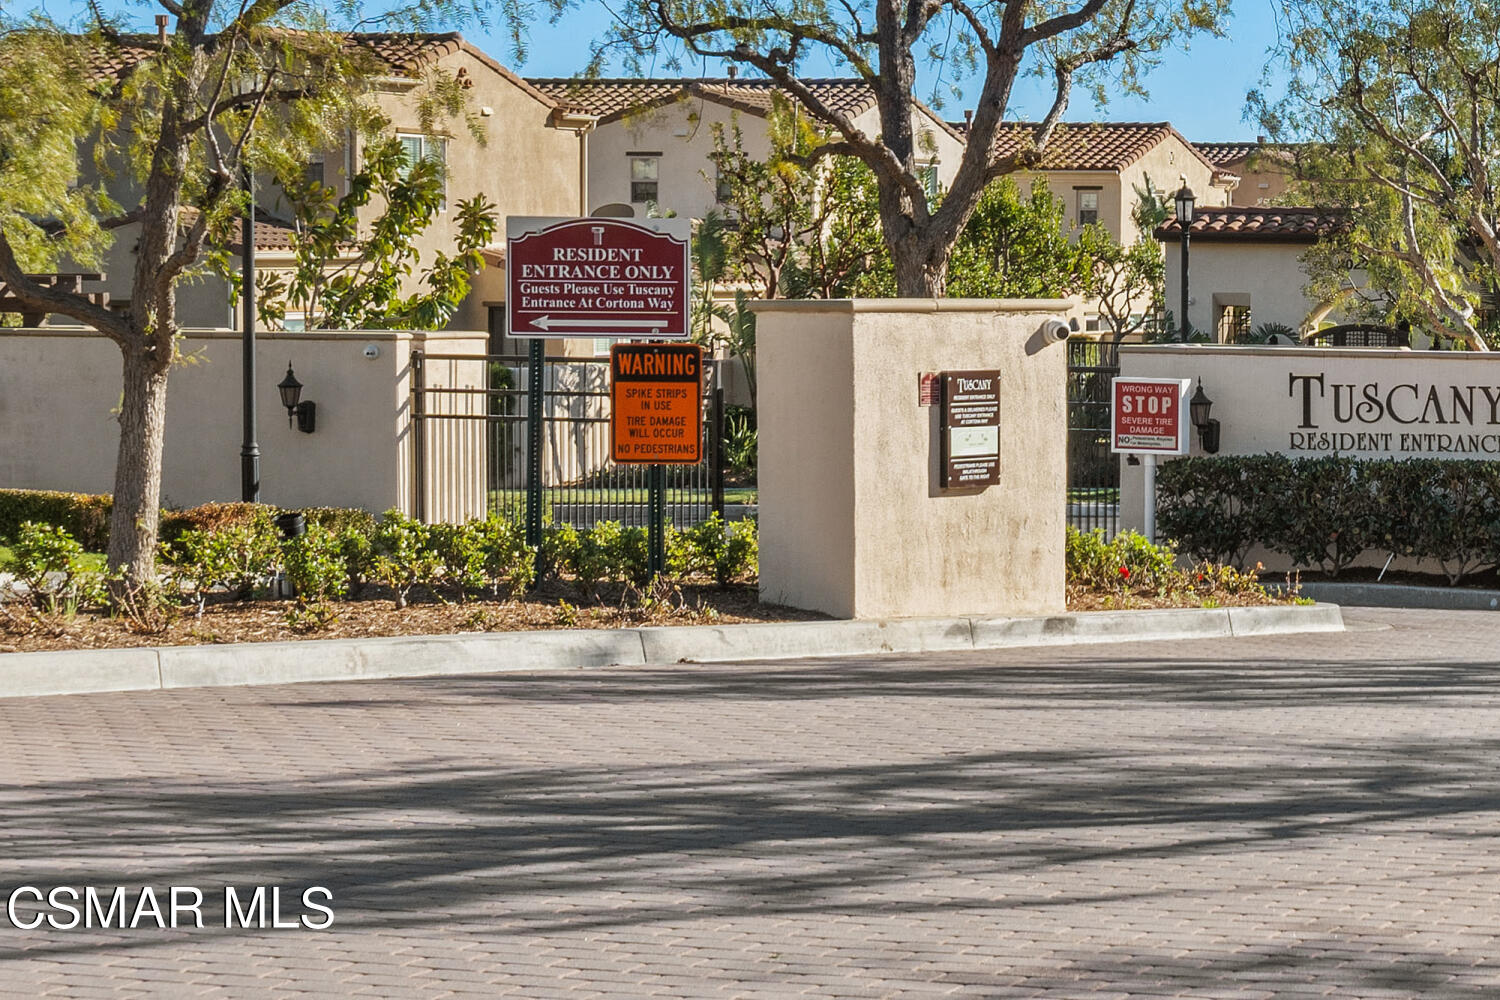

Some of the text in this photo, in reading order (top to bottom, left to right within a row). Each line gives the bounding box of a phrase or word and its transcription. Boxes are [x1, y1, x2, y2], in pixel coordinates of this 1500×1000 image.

[553, 248, 644, 262] RESIDENT
[522, 264, 674, 279] ENTRANCE ONLY
[520, 282, 675, 298] Guests Please Use Tuscany
[522, 296, 674, 312] Entrance At Cortona Way
[618, 353, 695, 376] WARNING
[957, 378, 992, 393] TUSCANY
[1122, 385, 1153, 393] WRONG
[626, 388, 688, 398] SPIKE STRIPS
[641, 401, 672, 410] IN USE
[1122, 395, 1172, 414] STOP
[626, 416, 686, 426] TIRE DAMAGE
[629, 428, 684, 438] WILL OCCUR
[1289, 432, 1392, 450] RESIDENT
[618, 444, 695, 454] NO PEDESTRIANS
